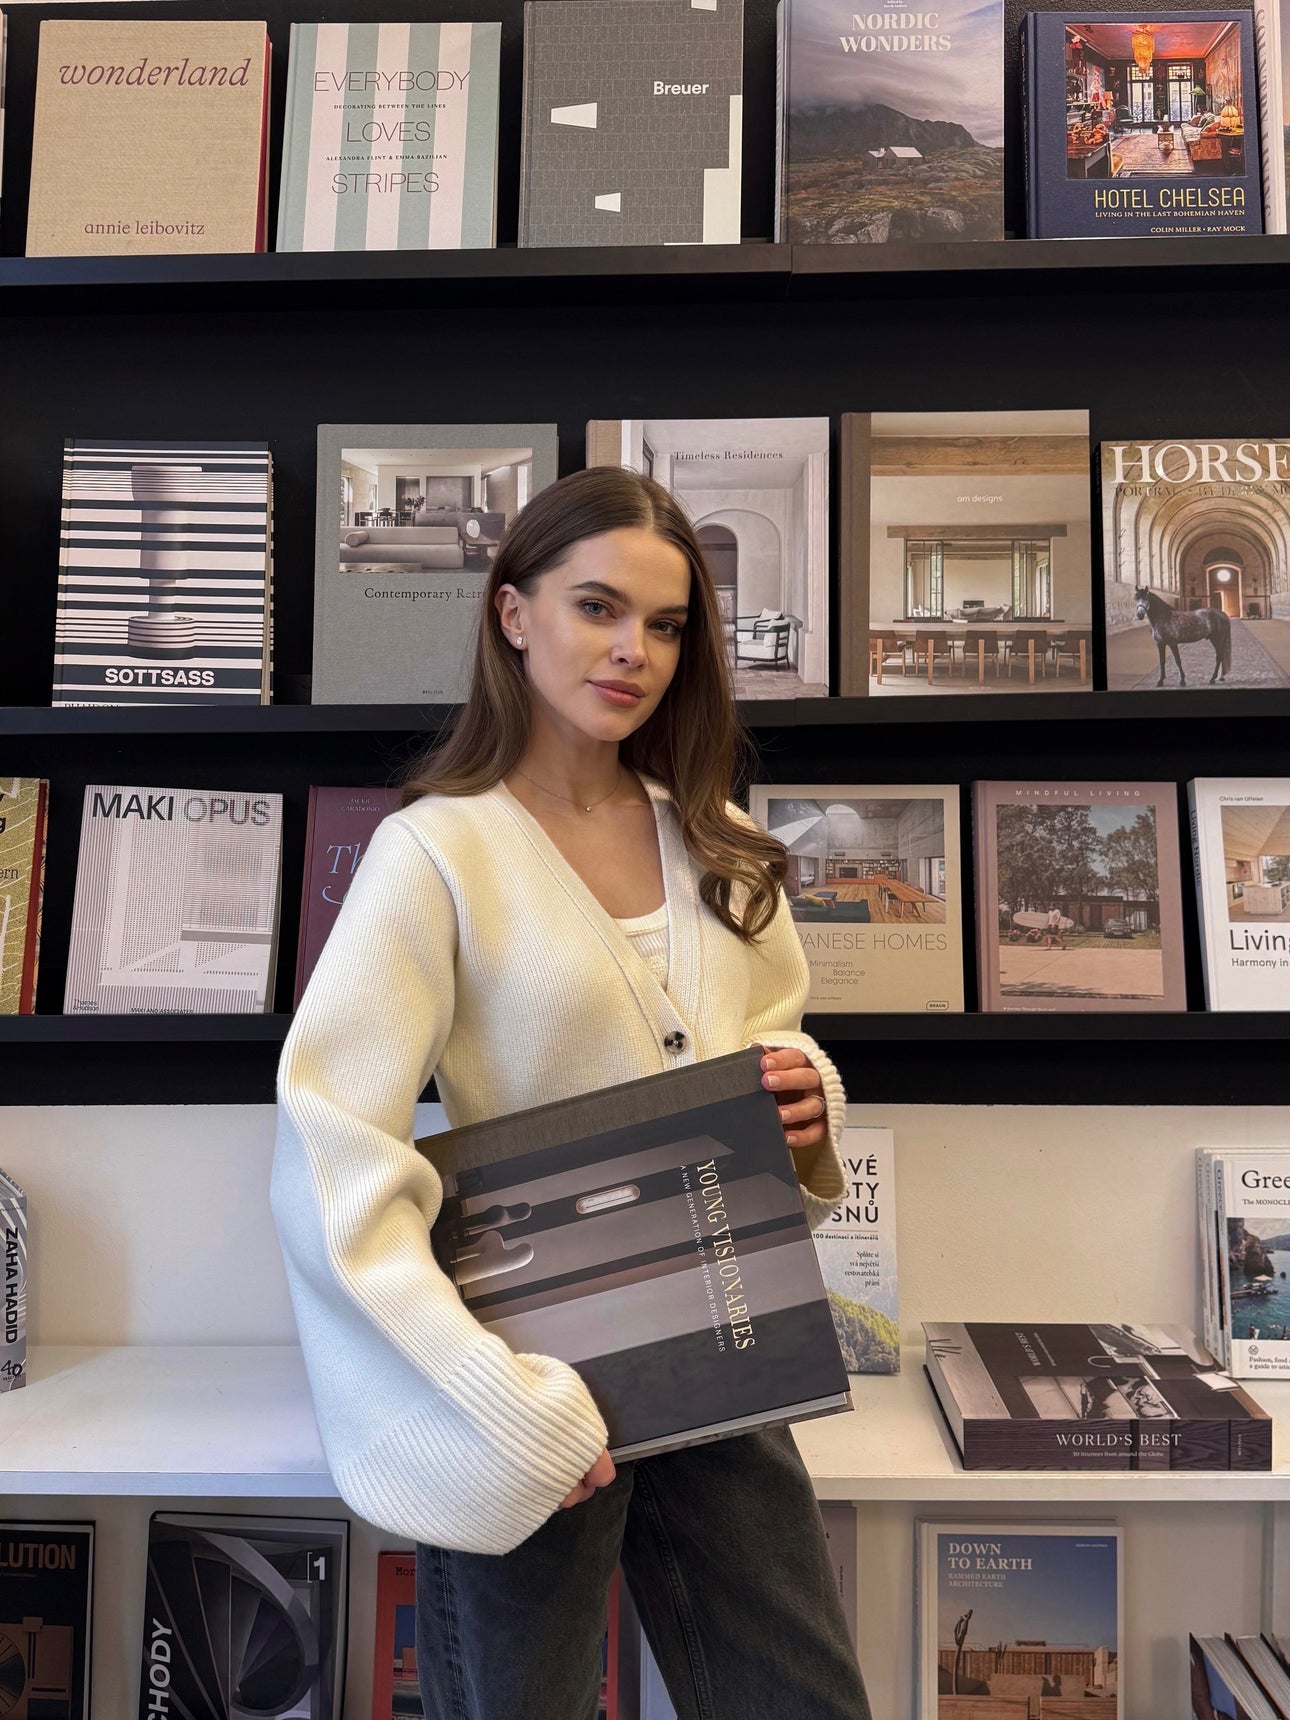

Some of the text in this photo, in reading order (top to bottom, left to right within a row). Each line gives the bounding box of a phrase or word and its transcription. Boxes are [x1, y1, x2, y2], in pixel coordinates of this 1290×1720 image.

[852, 12, 939, 30] NORDIC
[840, 35, 952, 53] WONDERS
[59, 57, 251, 87] wonderland
[314, 71, 470, 91] EVERYBODY
[653, 81, 709, 96] Breuer
[346, 121, 431, 142] LOVES
[331, 172, 440, 194] STRIPES
[1095, 187, 1245, 209] HOTEL CHELSEA
[84, 219, 205, 236] annie leibovitz
[673, 450, 784, 461] Timeless Residences
[972, 495, 1003, 504] designs
[364, 587, 484, 601] Contemporary Retr
[105, 668, 215, 686] SOTTSASS
[92, 792, 271, 826] MAKI OPUS
[873, 933, 947, 951] HOMES
[809, 960, 853, 968] Minimalism
[1231, 957, 1288, 969] Harmony in
[821, 977, 859, 986] Elegance
[843, 1154, 878, 1176] VÉ
[681, 1172, 691, 1191] NEW
[1241, 1169, 1290, 1189] Gree
[686, 1192, 703, 1245] GENERATION
[831, 1199, 879, 1224] SNŮ
[697, 1246, 706, 1257] OF
[697, 1159, 755, 1350] YOUNG VISIONARIES
[5, 1227, 18, 1344] ZAHA HADID
[701, 1260, 715, 1301] INTERIOR
[709, 1302, 726, 1352] DESIGNERS
[0, 1359, 22, 1378] 40
[1056, 1433, 1182, 1447] WORLD'S BEST
[948, 1543, 1002, 1555] DOWN
[948, 1558, 1033, 1570] TO EARTH
[948, 1580, 1004, 1588] ARCHITECTURE
[983, 1573, 1006, 1581] EARTH
